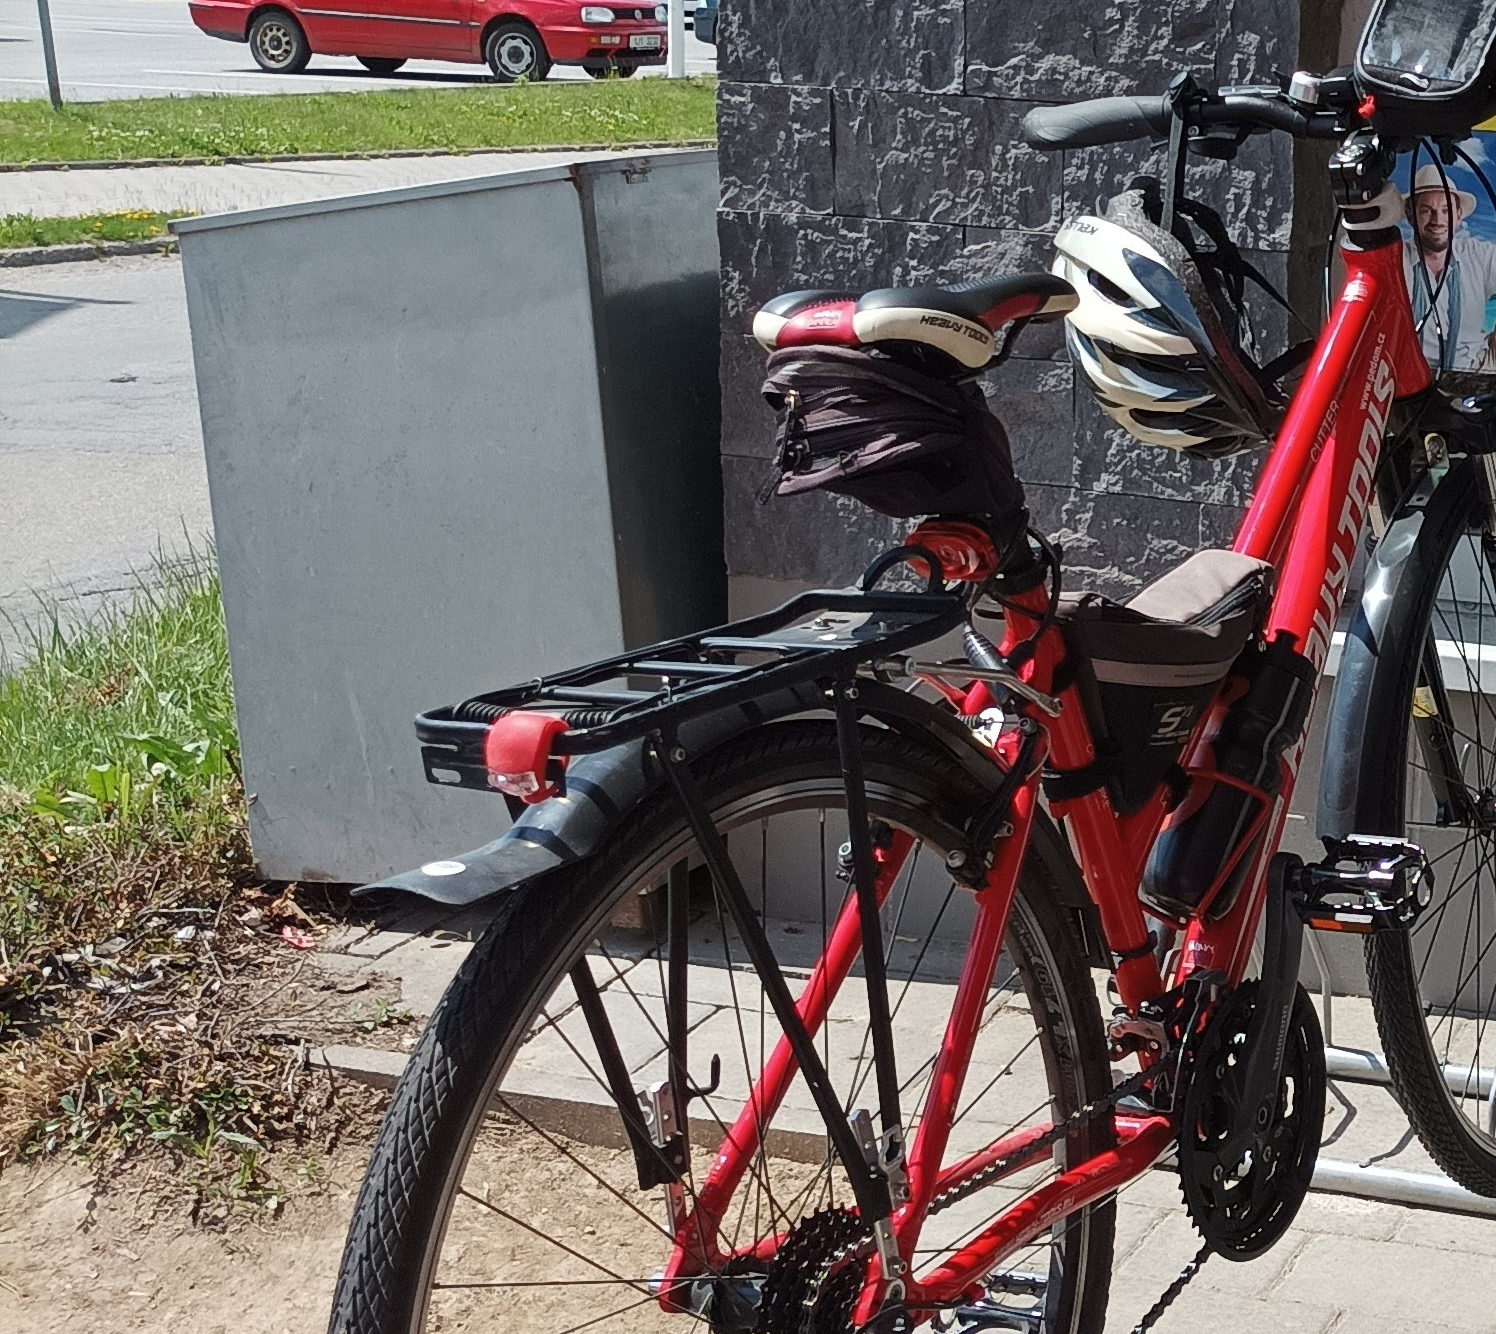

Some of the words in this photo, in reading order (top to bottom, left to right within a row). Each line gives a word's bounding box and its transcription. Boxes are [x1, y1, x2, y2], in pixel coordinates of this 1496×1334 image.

[1359, 332, 1386, 411] www.pedom.cz
[1310, 399, 1340, 463] CUTTER
[1337, 358, 1397, 549] TOOLS
